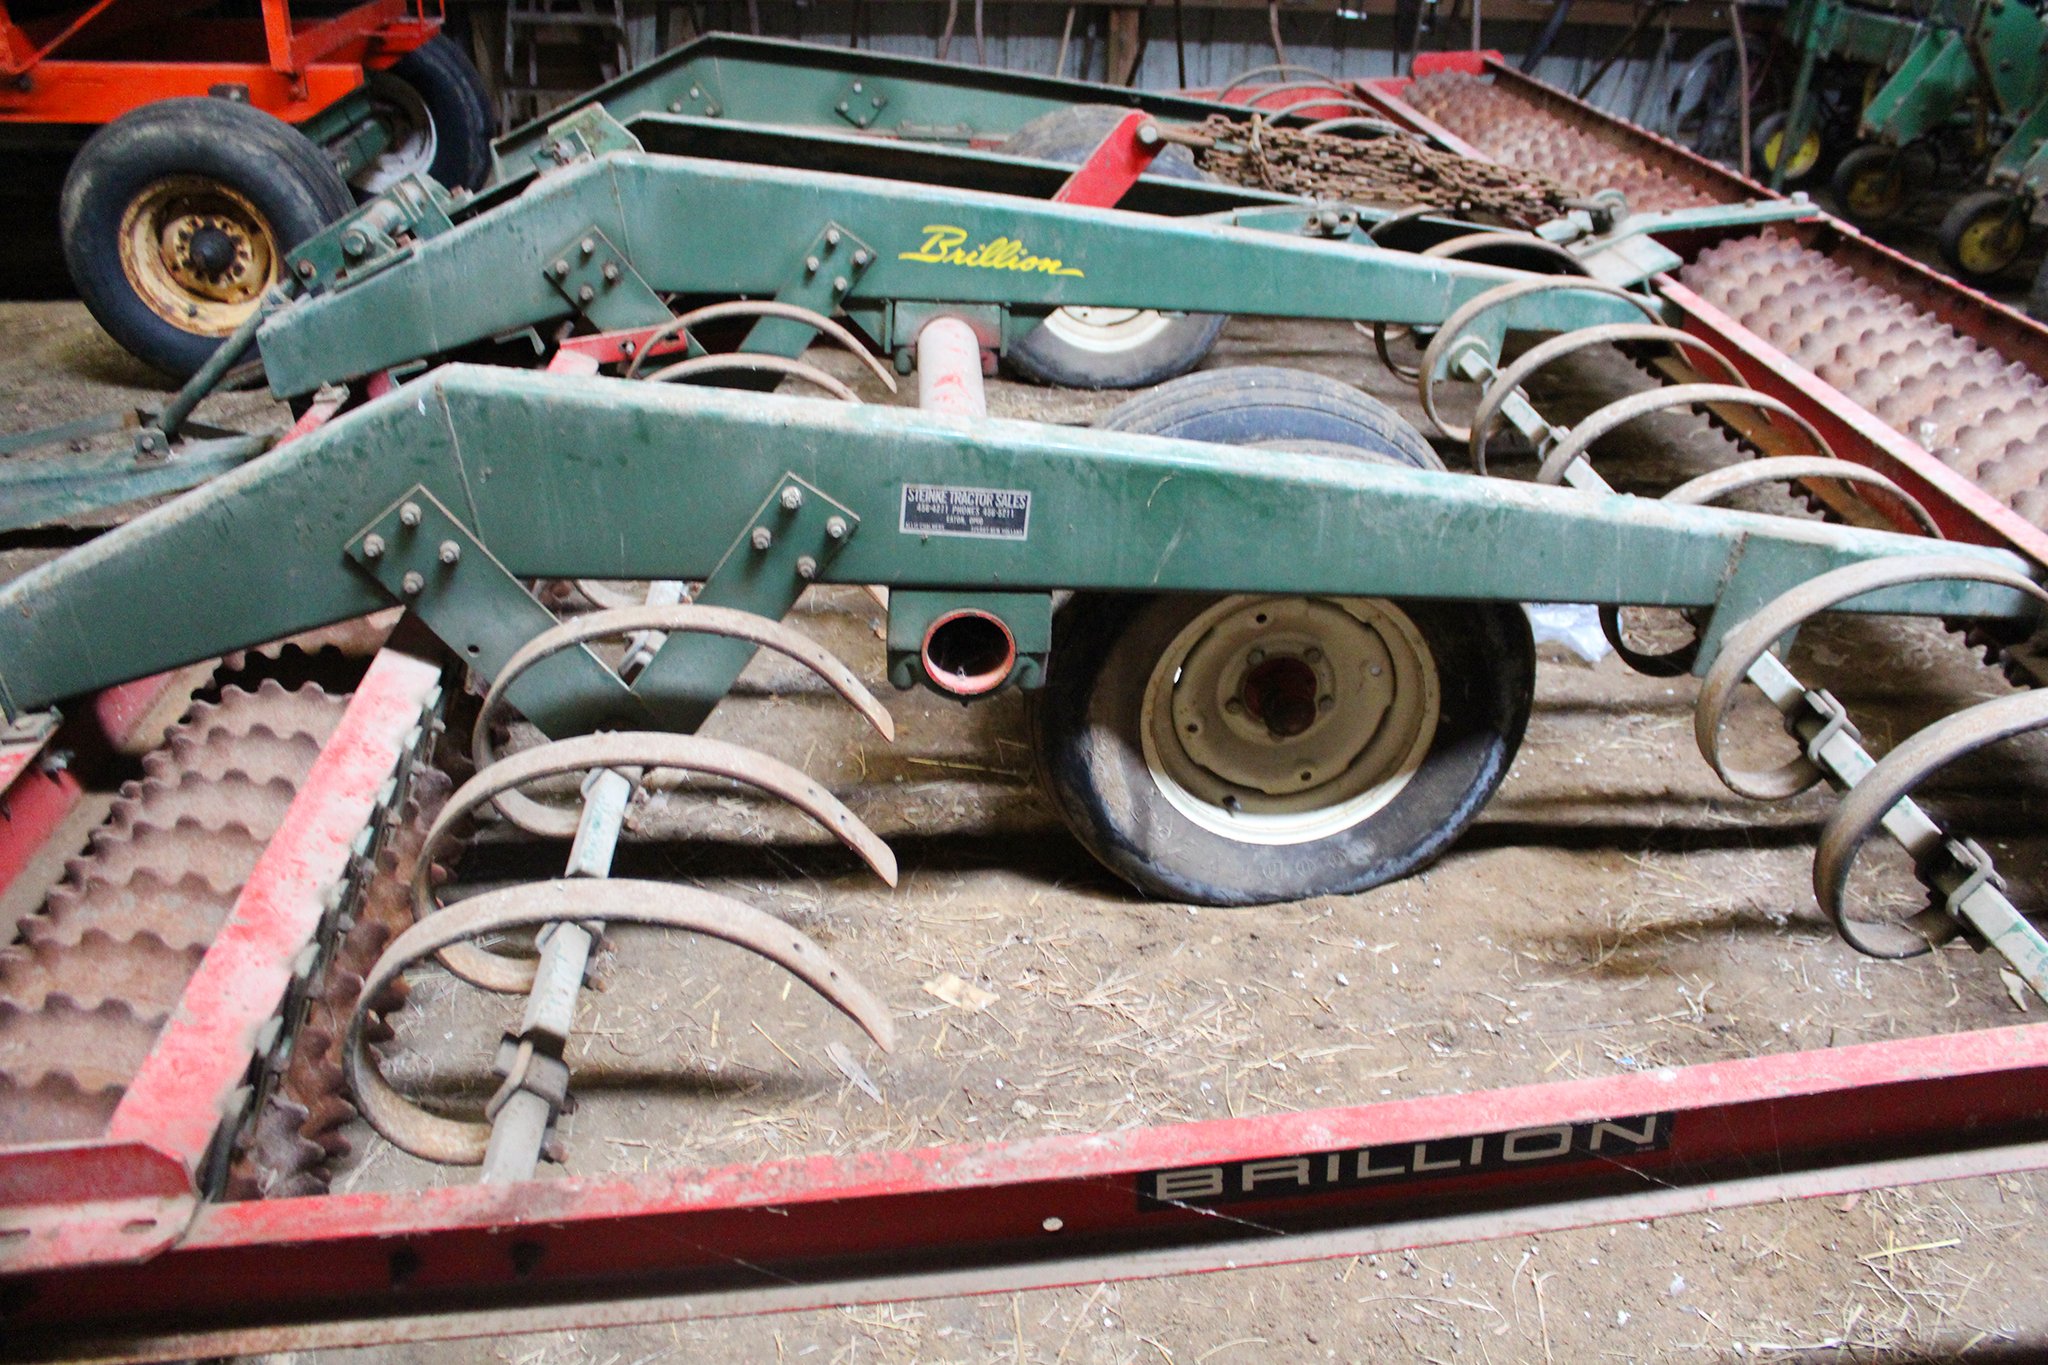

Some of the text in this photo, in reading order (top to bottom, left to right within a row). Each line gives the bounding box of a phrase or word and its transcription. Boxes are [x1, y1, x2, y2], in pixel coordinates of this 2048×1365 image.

[898, 224, 1085, 278] Brillion
[908, 488, 1026, 509] STEINKE TRACTOR SALES
[952, 505, 980, 516] PHONES
[1156, 1116, 1657, 1200] BRILLION
